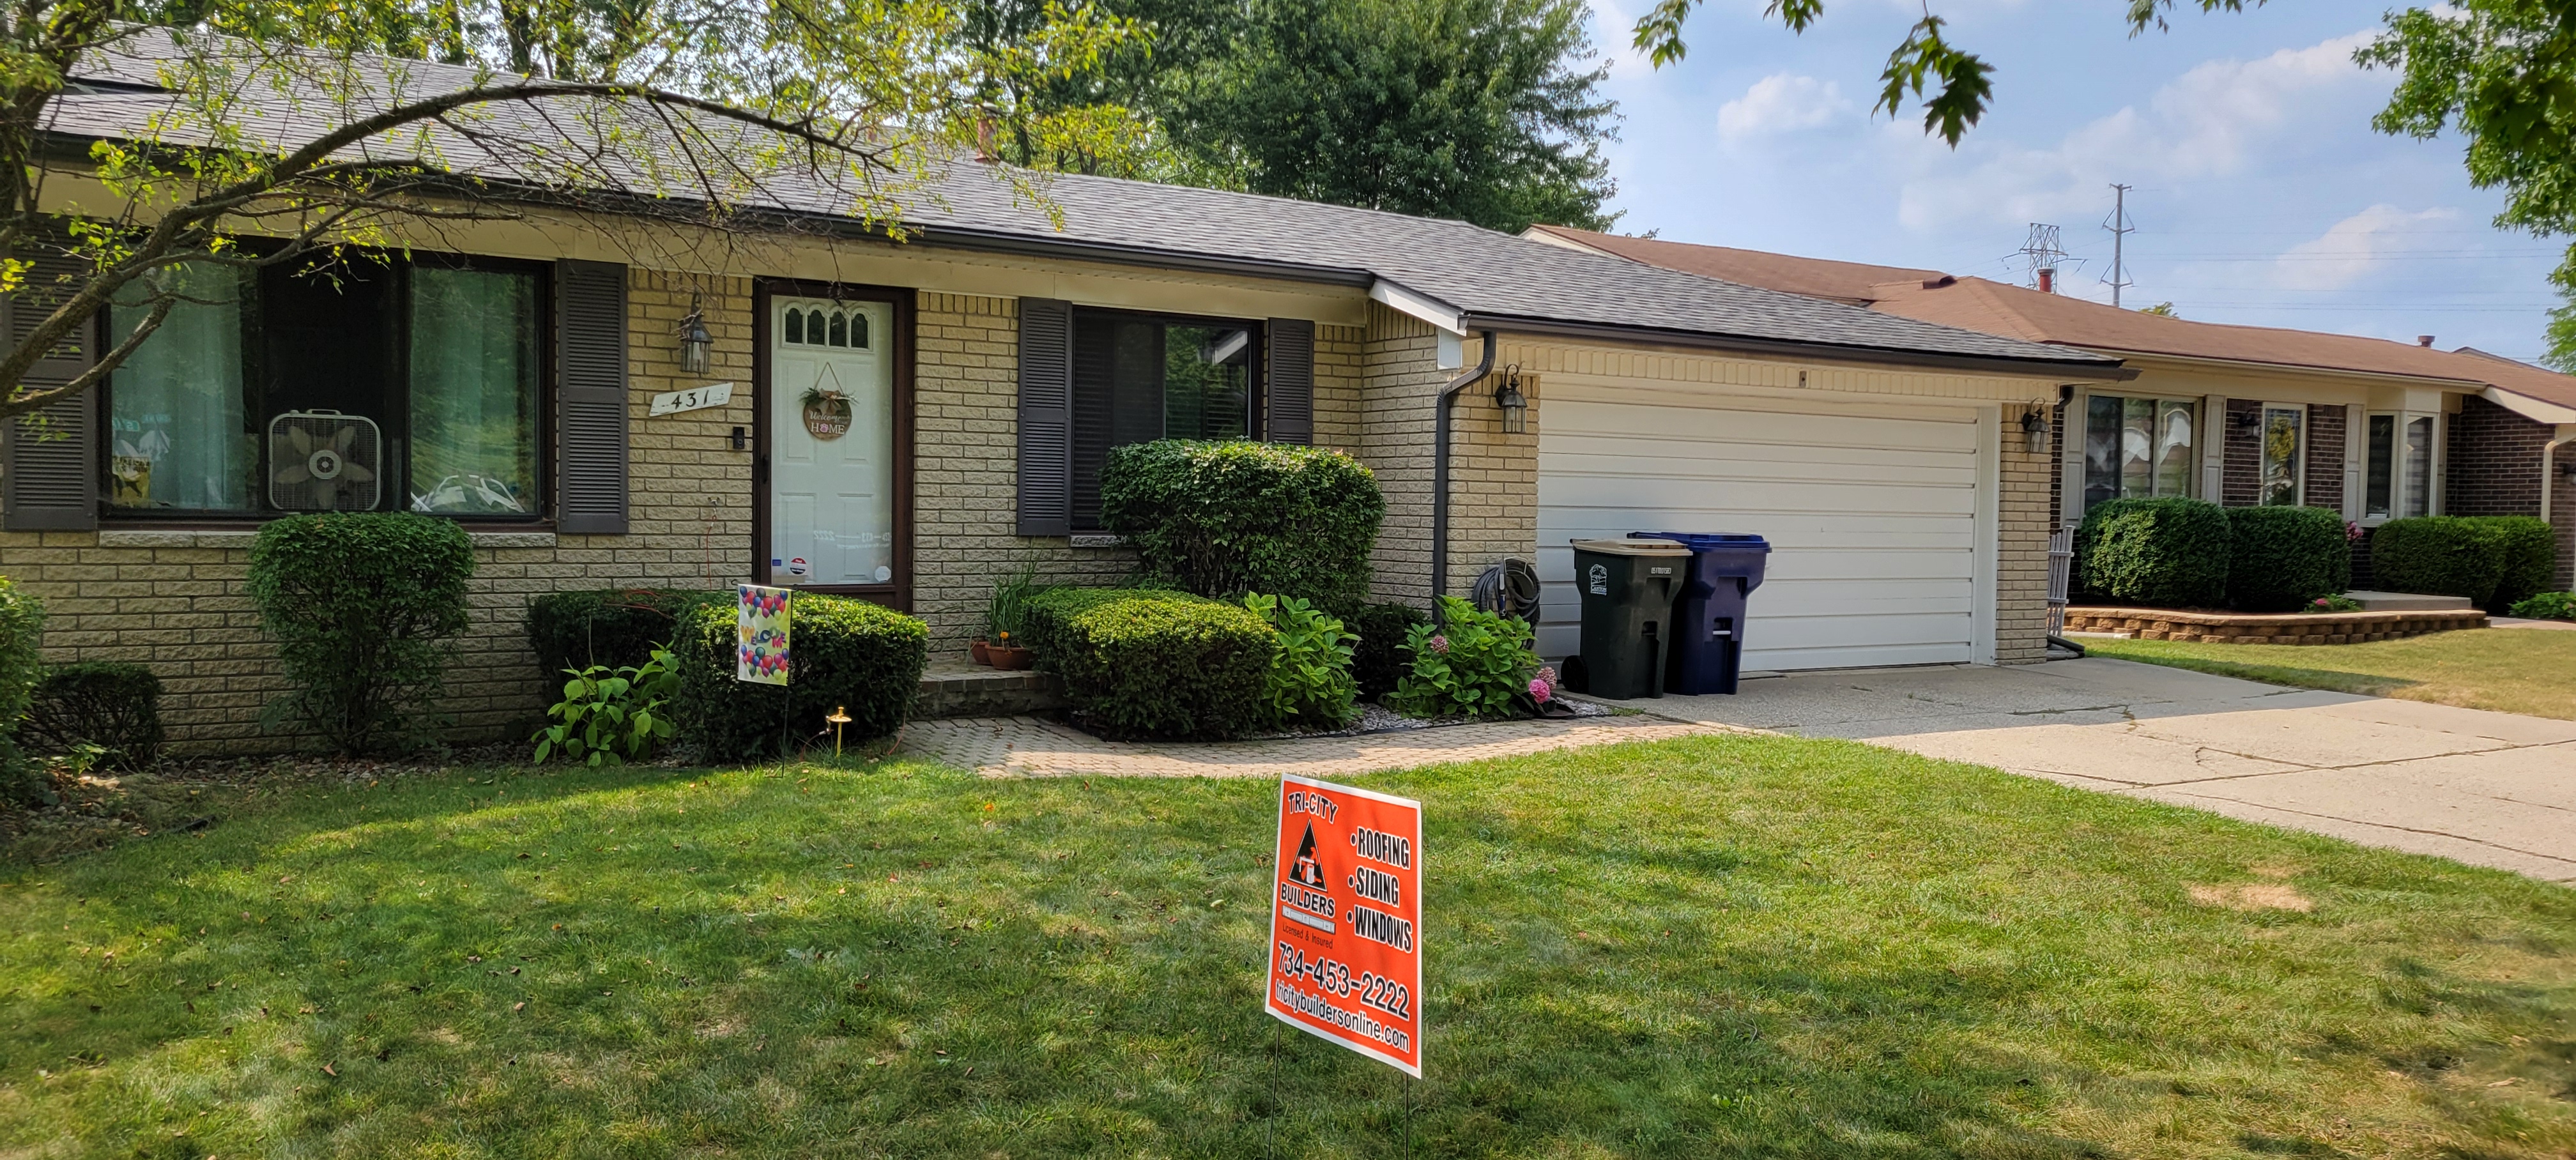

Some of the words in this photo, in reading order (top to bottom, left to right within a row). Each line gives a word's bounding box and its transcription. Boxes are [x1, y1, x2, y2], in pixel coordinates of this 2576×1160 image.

[671, 390, 709, 409] 431
[809, 409, 841, 422] Welcome
[740, 625, 786, 648] WELCOME
[1289, 792, 1338, 824] TRI-CITY
[1358, 827, 1410, 869] ROOFING
[1280, 882, 1335, 918] BUILDERS
[1356, 866, 1399, 908] SIDING
[1283, 922, 1303, 939] Licensed
[1305, 930, 1310, 941] &
[1312, 933, 1333, 949] Insured
[1354, 904, 1412, 953] WINDOWS
[1278, 941, 1409, 1021] 734-453-2222
[1276, 979, 1409, 1053] tricitybuildersonline.com
